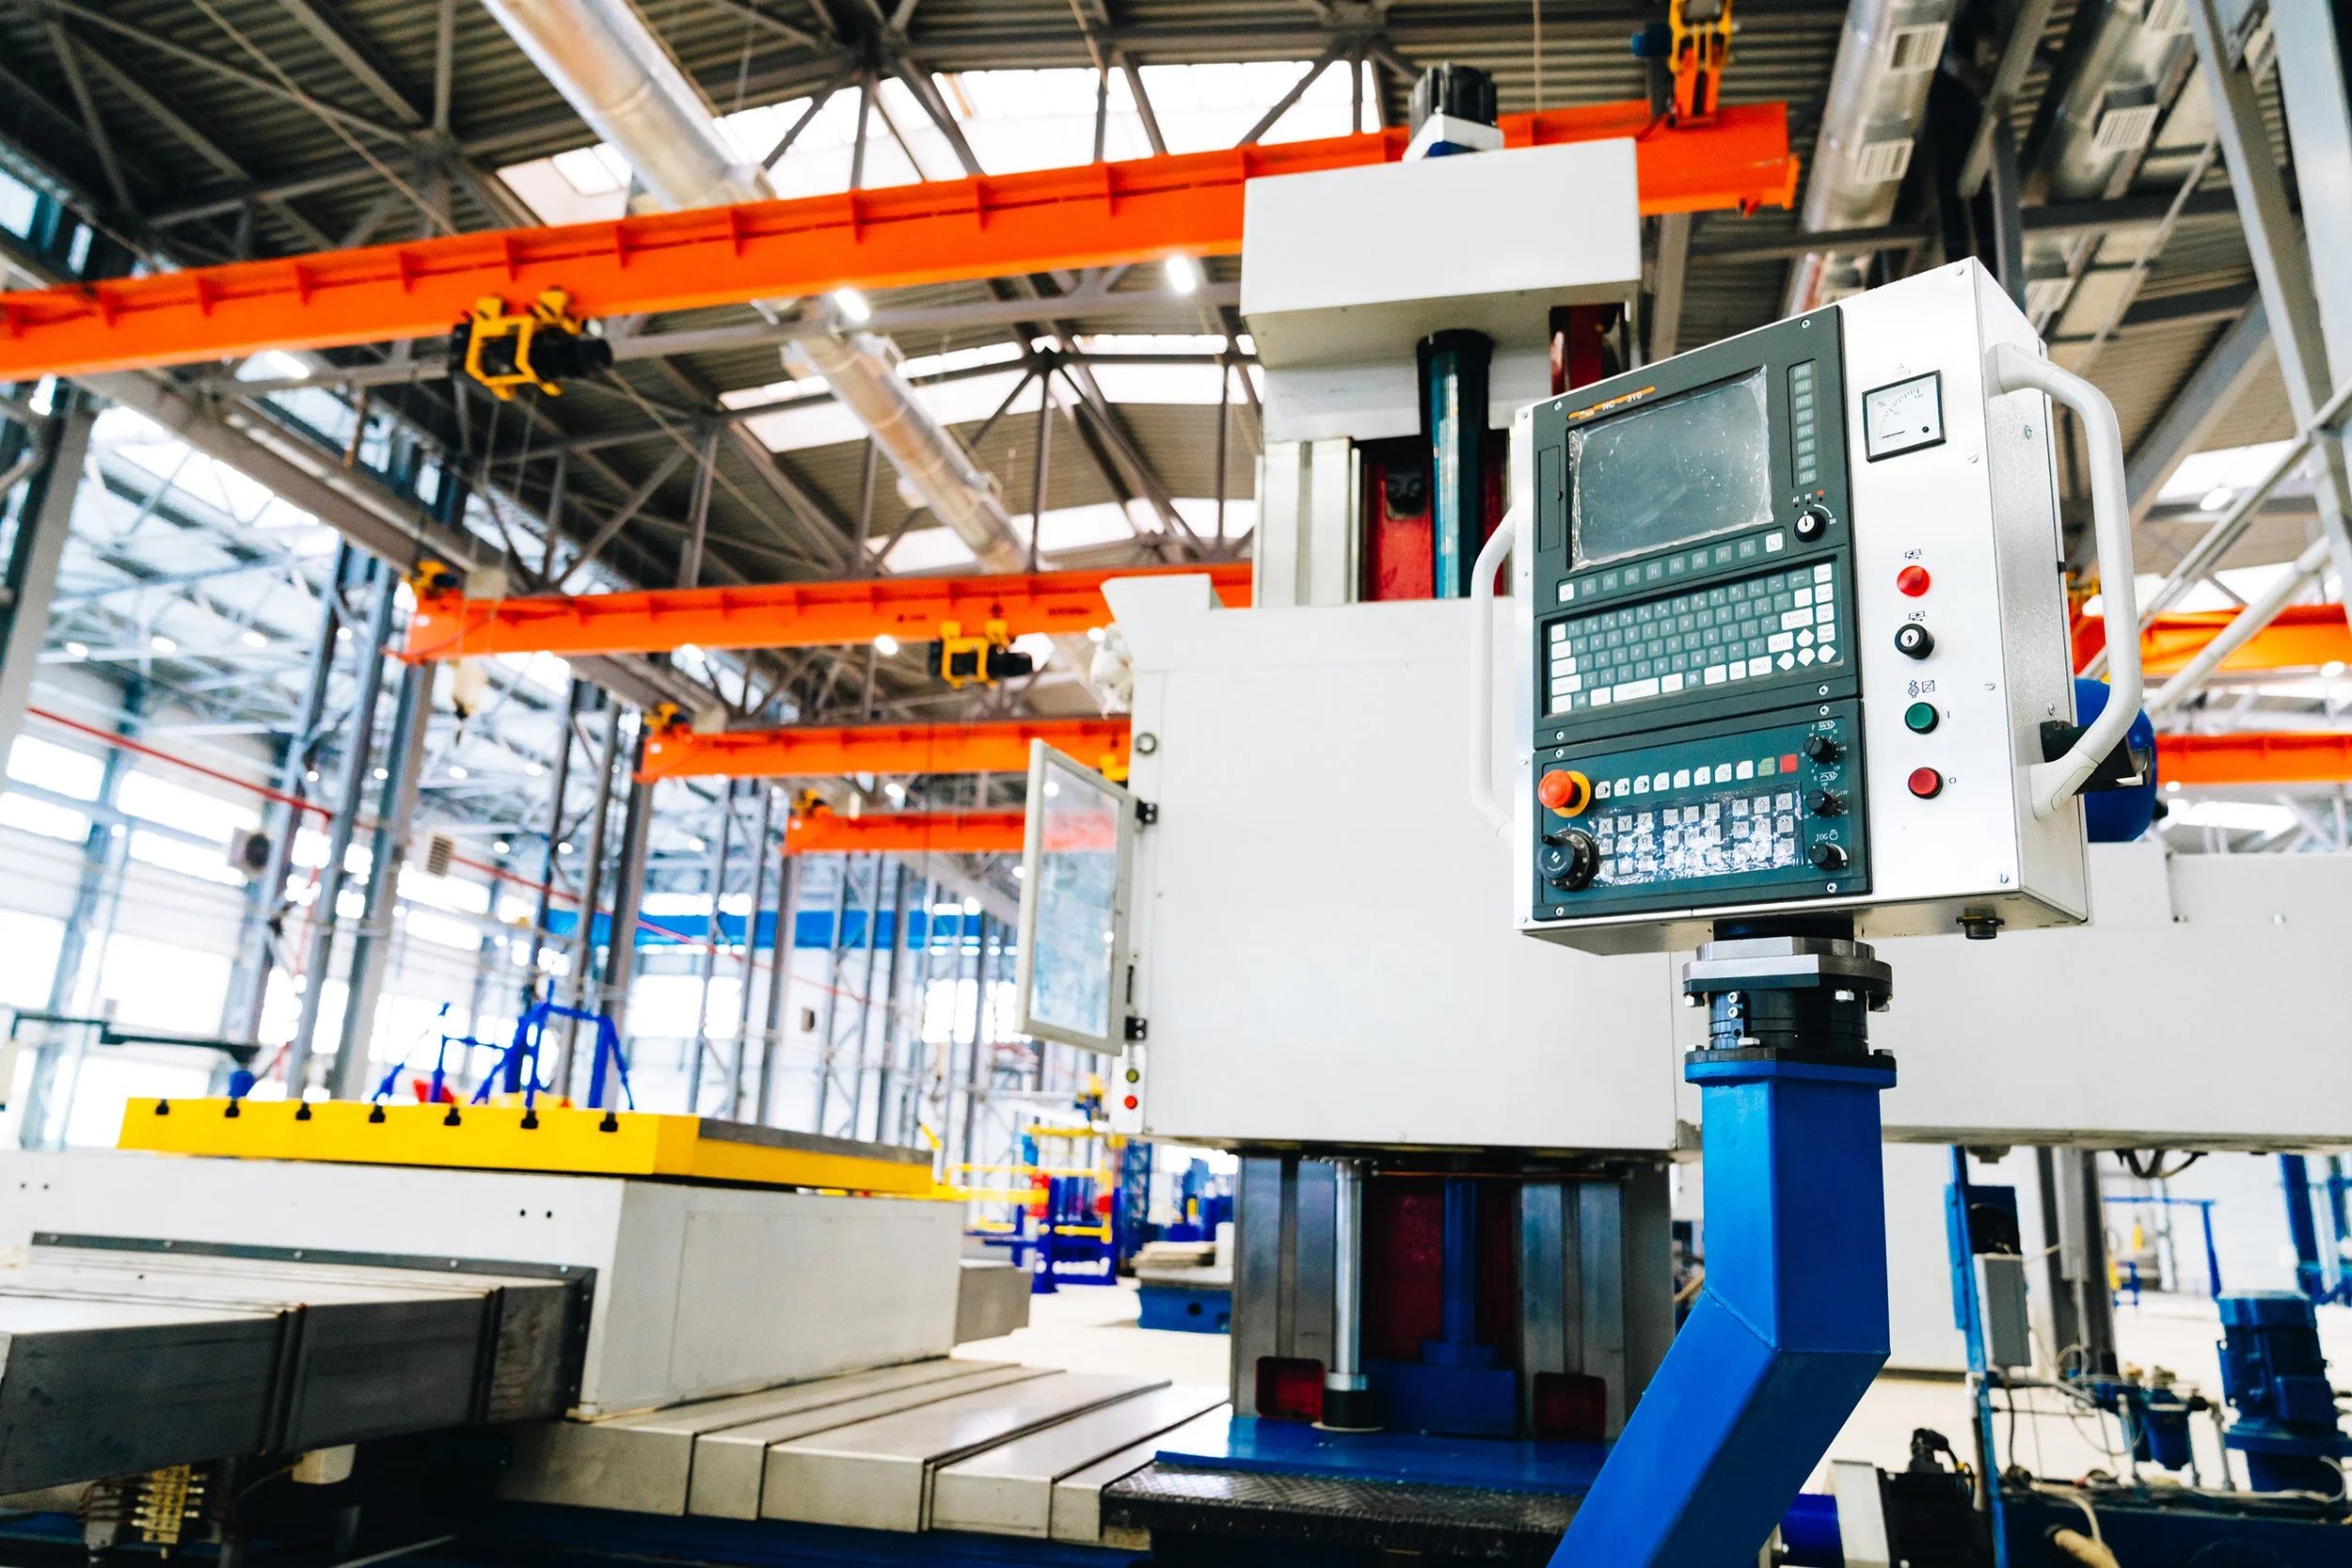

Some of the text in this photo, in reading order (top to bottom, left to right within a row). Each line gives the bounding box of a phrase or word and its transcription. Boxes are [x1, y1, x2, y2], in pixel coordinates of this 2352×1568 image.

[1602, 401, 1615, 410] NC
[1627, 391, 1643, 403] 310
[1815, 832, 1829, 843] JOG
